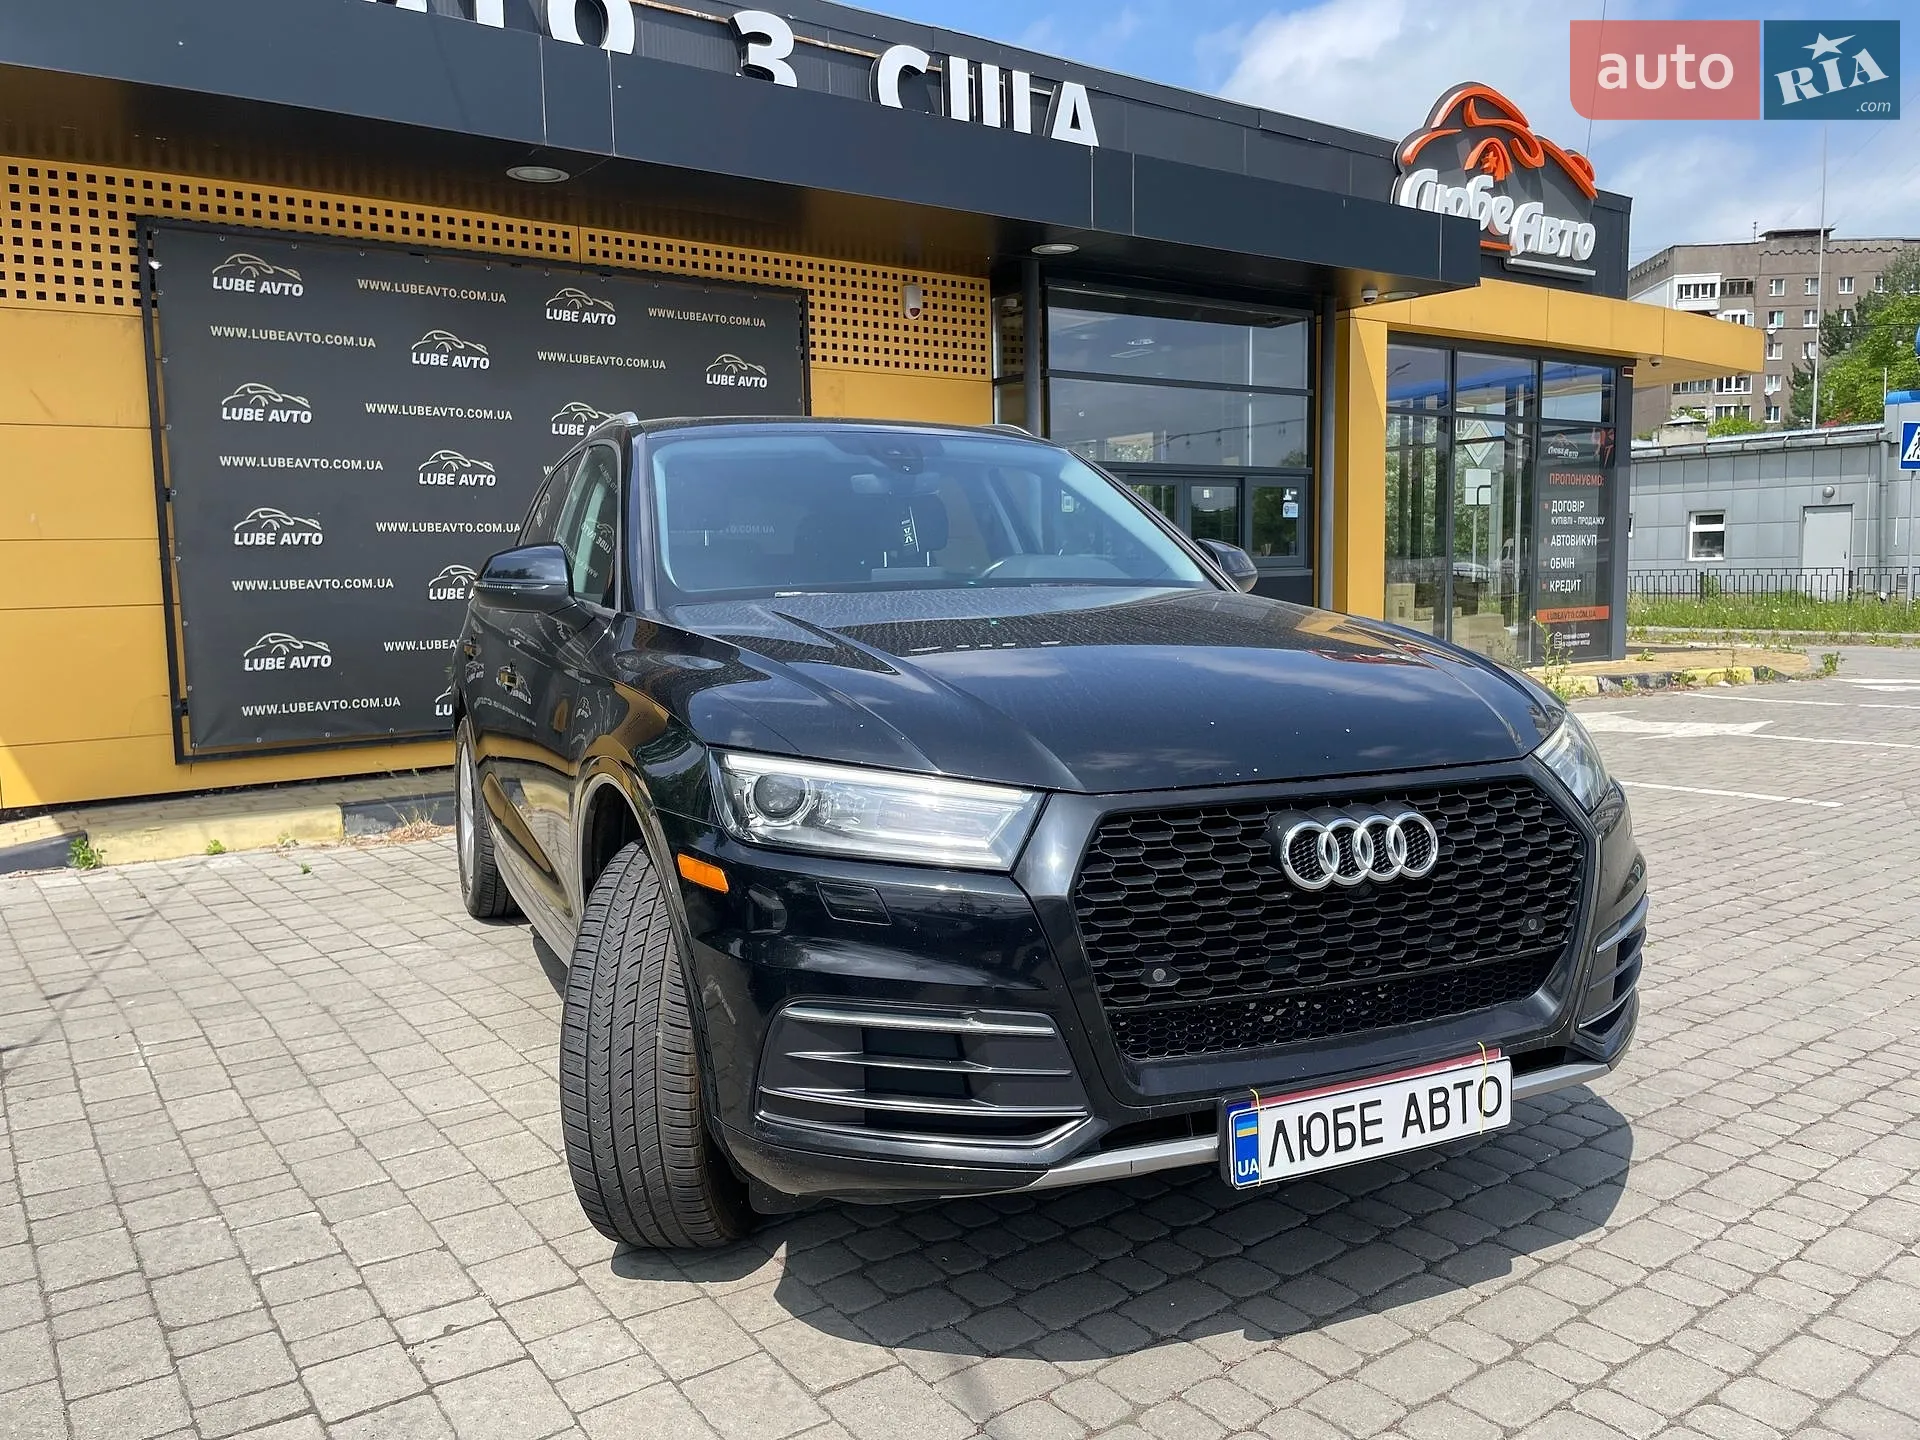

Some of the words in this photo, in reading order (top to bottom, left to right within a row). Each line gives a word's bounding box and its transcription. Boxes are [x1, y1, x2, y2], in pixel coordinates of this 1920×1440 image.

[212, 275, 257, 292] LUBE
[259, 280, 304, 297] AVTO
[357, 278, 507, 303] WWW.LUBEAVTO.COM.UA
[546, 307, 579, 323] LUBE
[582, 310, 617, 326] AVTO
[648, 307, 766, 328] WWW.LUBEAVTO.COM.UA
[210, 325, 377, 348] WWW.LUBEAVTO.COM.UA
[412, 351, 449, 367] LUBE
[452, 354, 490, 370] AVTO
[537, 351, 666, 370] WWW.LUBEAVTO.COM.UA
[706, 372, 736, 387] LUBE
[737, 374, 768, 388] AVTO
[221, 407, 264, 422] LUBE
[268, 408, 312, 424] AVTO
[365, 402, 513, 421] WWW.LUBEAVTO.COM.UA
[551, 423, 585, 436] LUBE
[219, 455, 384, 472] WWW.LUBEAVTO.COM.UA
[418, 472, 456, 487] LUBE
[458, 472, 497, 487] AVTO
[1551, 500, 1585, 514] ДОГОВІР
[375, 522, 521, 533] WWW.LUBEAVTO.COM.UA
[1577, 516, 1606, 526] ПРОДАЖУ
[233, 532, 277, 546] LUBE
[280, 532, 324, 546] AVTO
[1550, 534, 1597, 547] АВТОВИКУП
[1550, 557, 1575, 569] ОБМІН
[231, 578, 394, 592] WWW.LUBEAVTO.COM.UA
[428, 587, 465, 600] LUBE
[1549, 579, 1582, 593] КРЕДИТ
[244, 656, 286, 672] LUBE
[289, 654, 332, 671] AVTO
[241, 696, 401, 717] WWW.LUBEAVTO.COM.UA
[435, 704, 453, 716] LU
[1268, 1098, 1384, 1168] ЛЮБЕ
[1401, 1075, 1503, 1139] АВТО
[1237, 1158, 1260, 1177] UA
